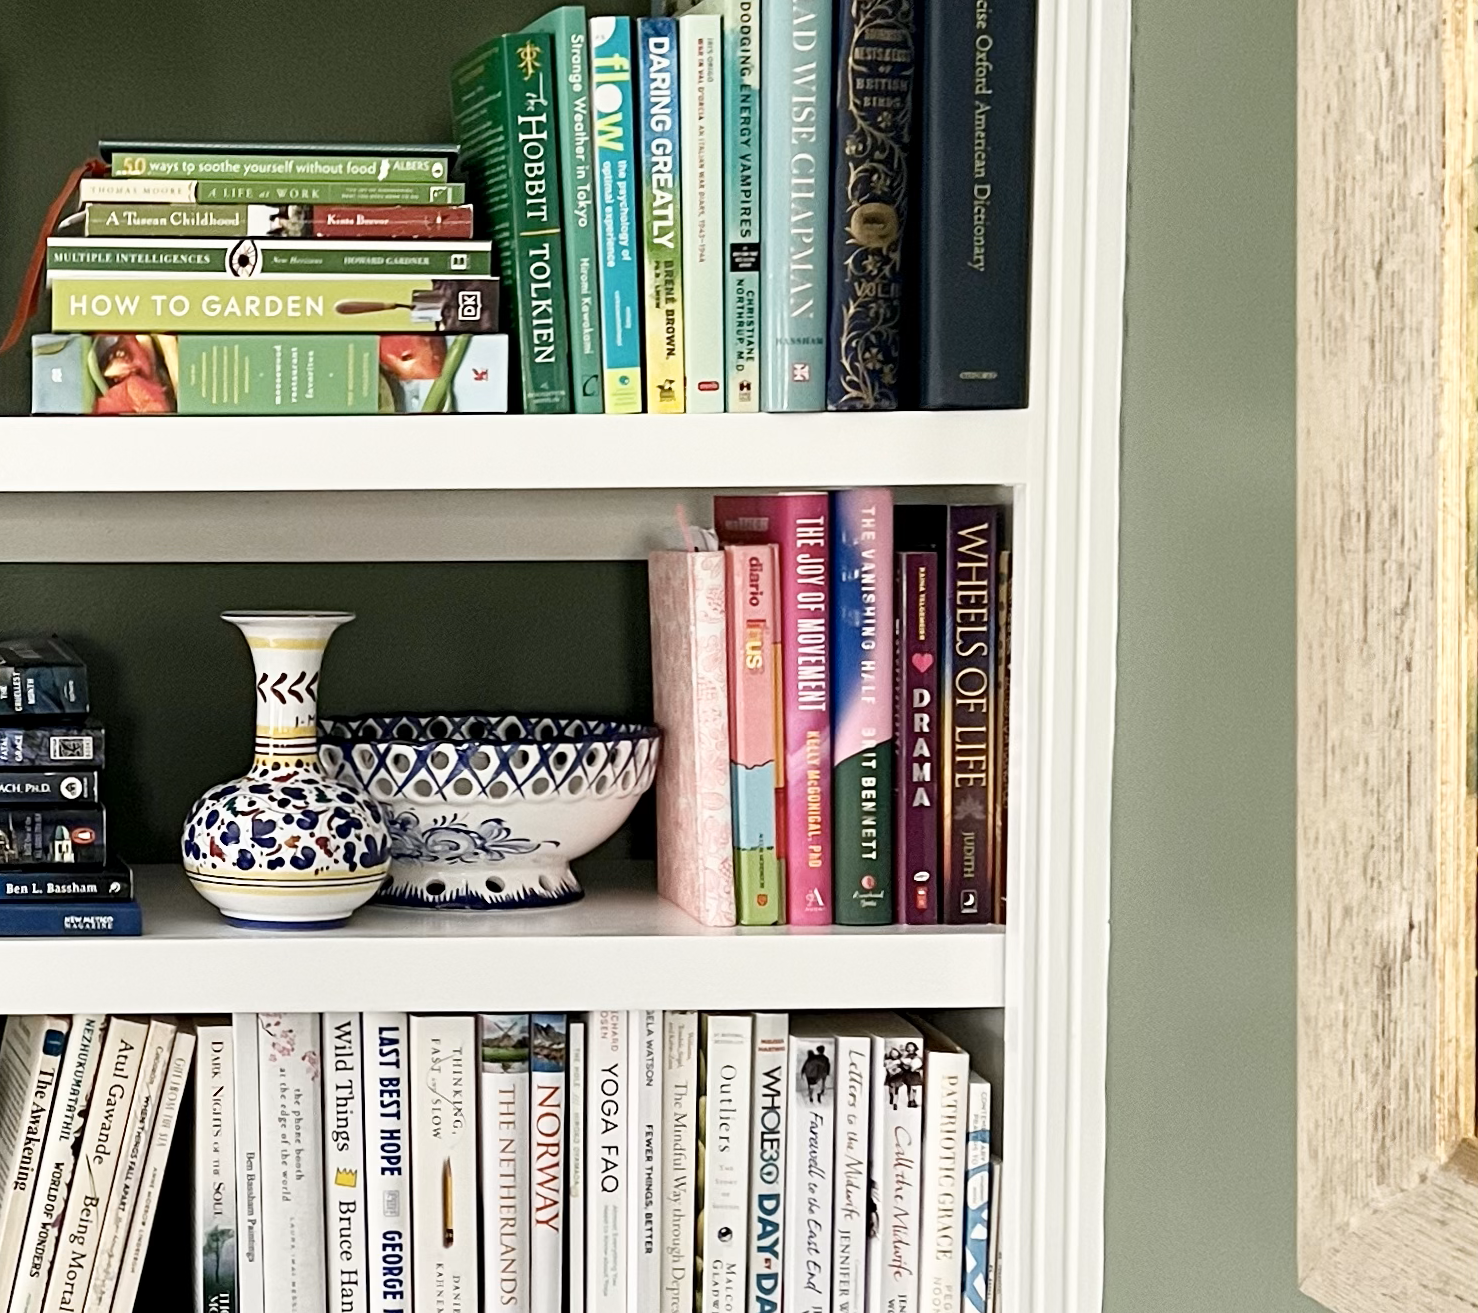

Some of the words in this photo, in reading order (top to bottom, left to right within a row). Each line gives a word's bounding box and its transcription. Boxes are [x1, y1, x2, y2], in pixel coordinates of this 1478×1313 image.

[648, 36, 672, 135] DARING
[976, 36, 992, 94] Oxford
[793, 63, 817, 147] WISE
[150, 160, 179, 176] ways
[183, 161, 195, 174] to
[199, 158, 241, 175] soothe
[244, 157, 293, 176] yourself
[297, 158, 343, 174] without
[346, 158, 377, 174] food
[518, 115, 548, 221] HOBBIT
[975, 102, 991, 179] American
[648, 139, 675, 248] GREATLY
[790, 153, 816, 319] CHAPMAN
[967, 184, 991, 272] Dictionary
[70, 296, 140, 316] HOW
[151, 296, 190, 316] TO
[202, 295, 324, 317] GARDEN
[529, 244, 555, 364] TOLKIEN
[796, 516, 824, 547] THE
[797, 552, 825, 585] JOY
[955, 523, 988, 659] WHEELS
[798, 591, 825, 612] OF
[798, 619, 826, 712] MOVEMENT
[955, 666, 988, 712] OF
[955, 724, 986, 787] LIFE
[6, 881, 28, 894] Ben
[47, 881, 97, 894] Bassham
[112, 1038, 136, 1080] Atul
[333, 1020, 355, 1073] Wild
[378, 1026, 400, 1069] LAST
[91, 1083, 125, 1166] Gawande
[331, 1080, 354, 1152] Things
[379, 1077, 401, 1120] BEST
[499, 1084, 516, 1130] THE
[600, 1063, 618, 1134] YOGA
[380, 1130, 402, 1176] HOPE
[536, 1083, 561, 1233] NORWAY
[601, 1144, 619, 1194] FAQ
[71, 1194, 100, 1251] Being
[338, 1200, 356, 1262] Bruce
[499, 1137, 518, 1306] NETHERLANDS
[58, 1253, 87, 1313] Mortal
[383, 1230, 404, 1301] GEORGE
